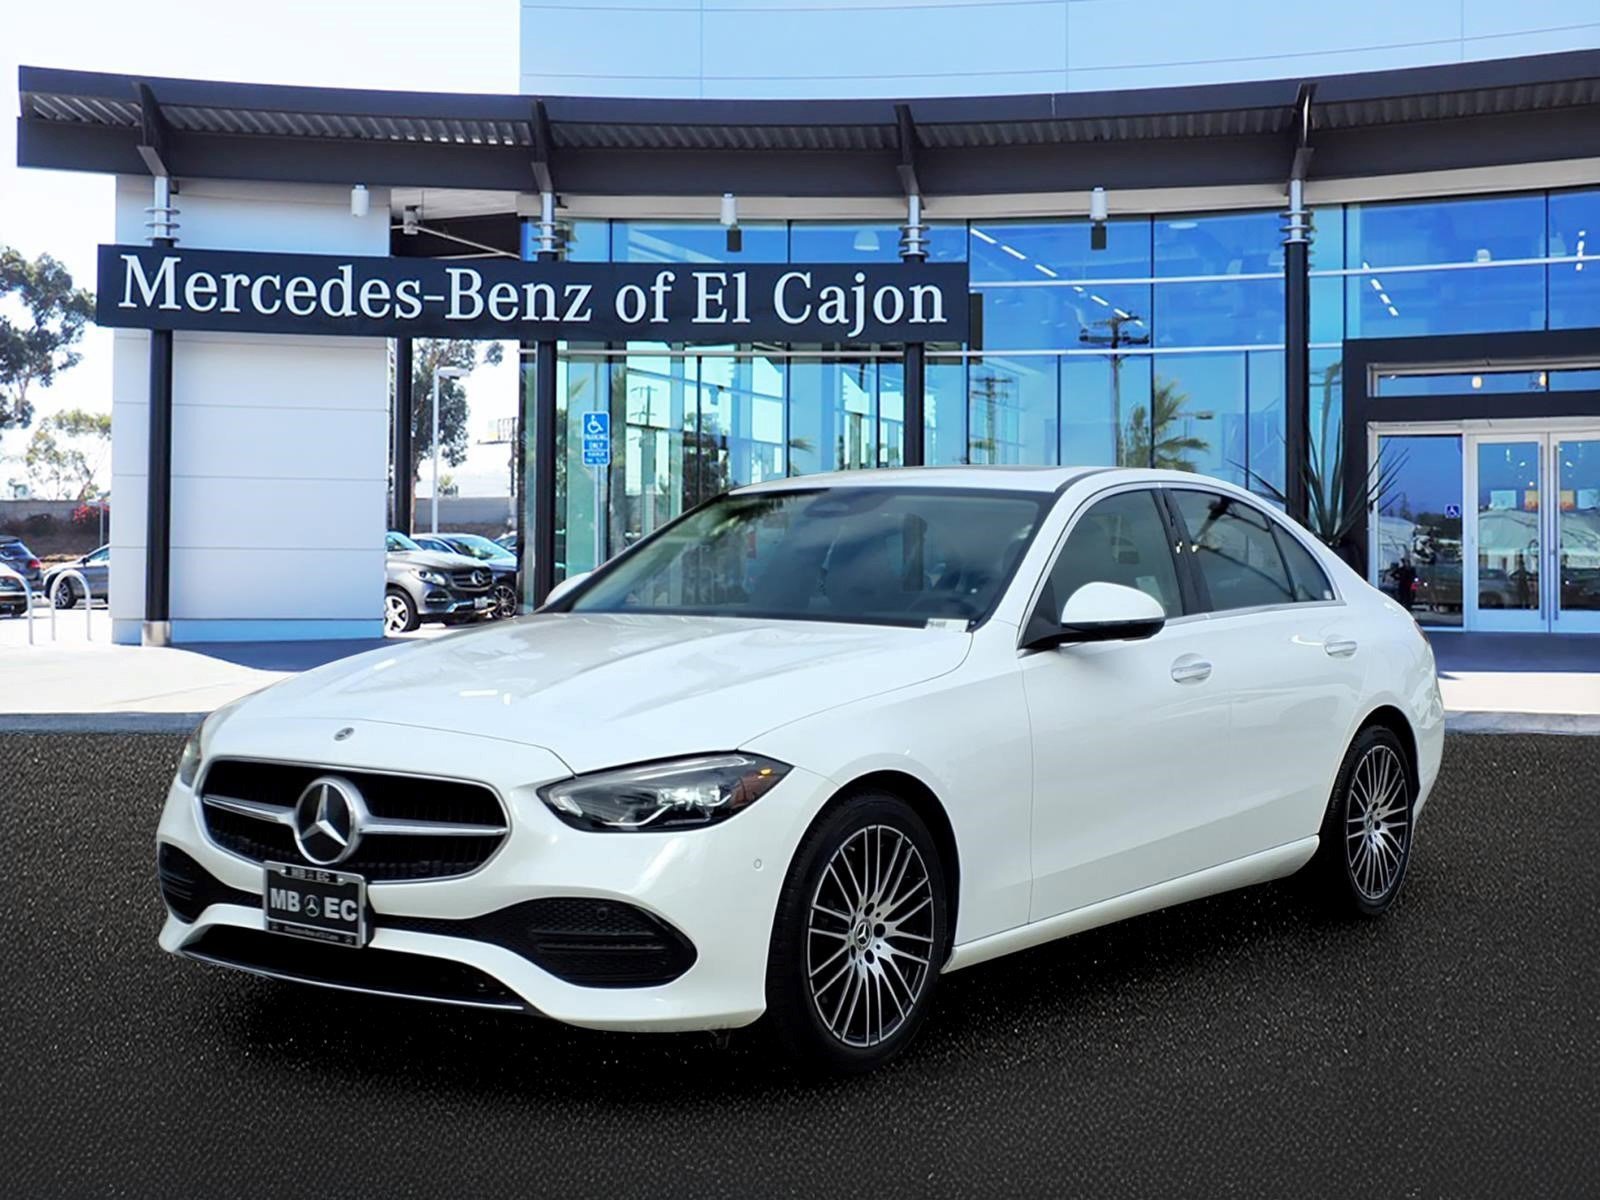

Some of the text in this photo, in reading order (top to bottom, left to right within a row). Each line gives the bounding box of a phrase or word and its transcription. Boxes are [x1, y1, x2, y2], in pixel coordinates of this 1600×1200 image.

[118, 254, 947, 338] Mercedes-Benz of El Cajon
[270, 887, 357, 922] MB EC
